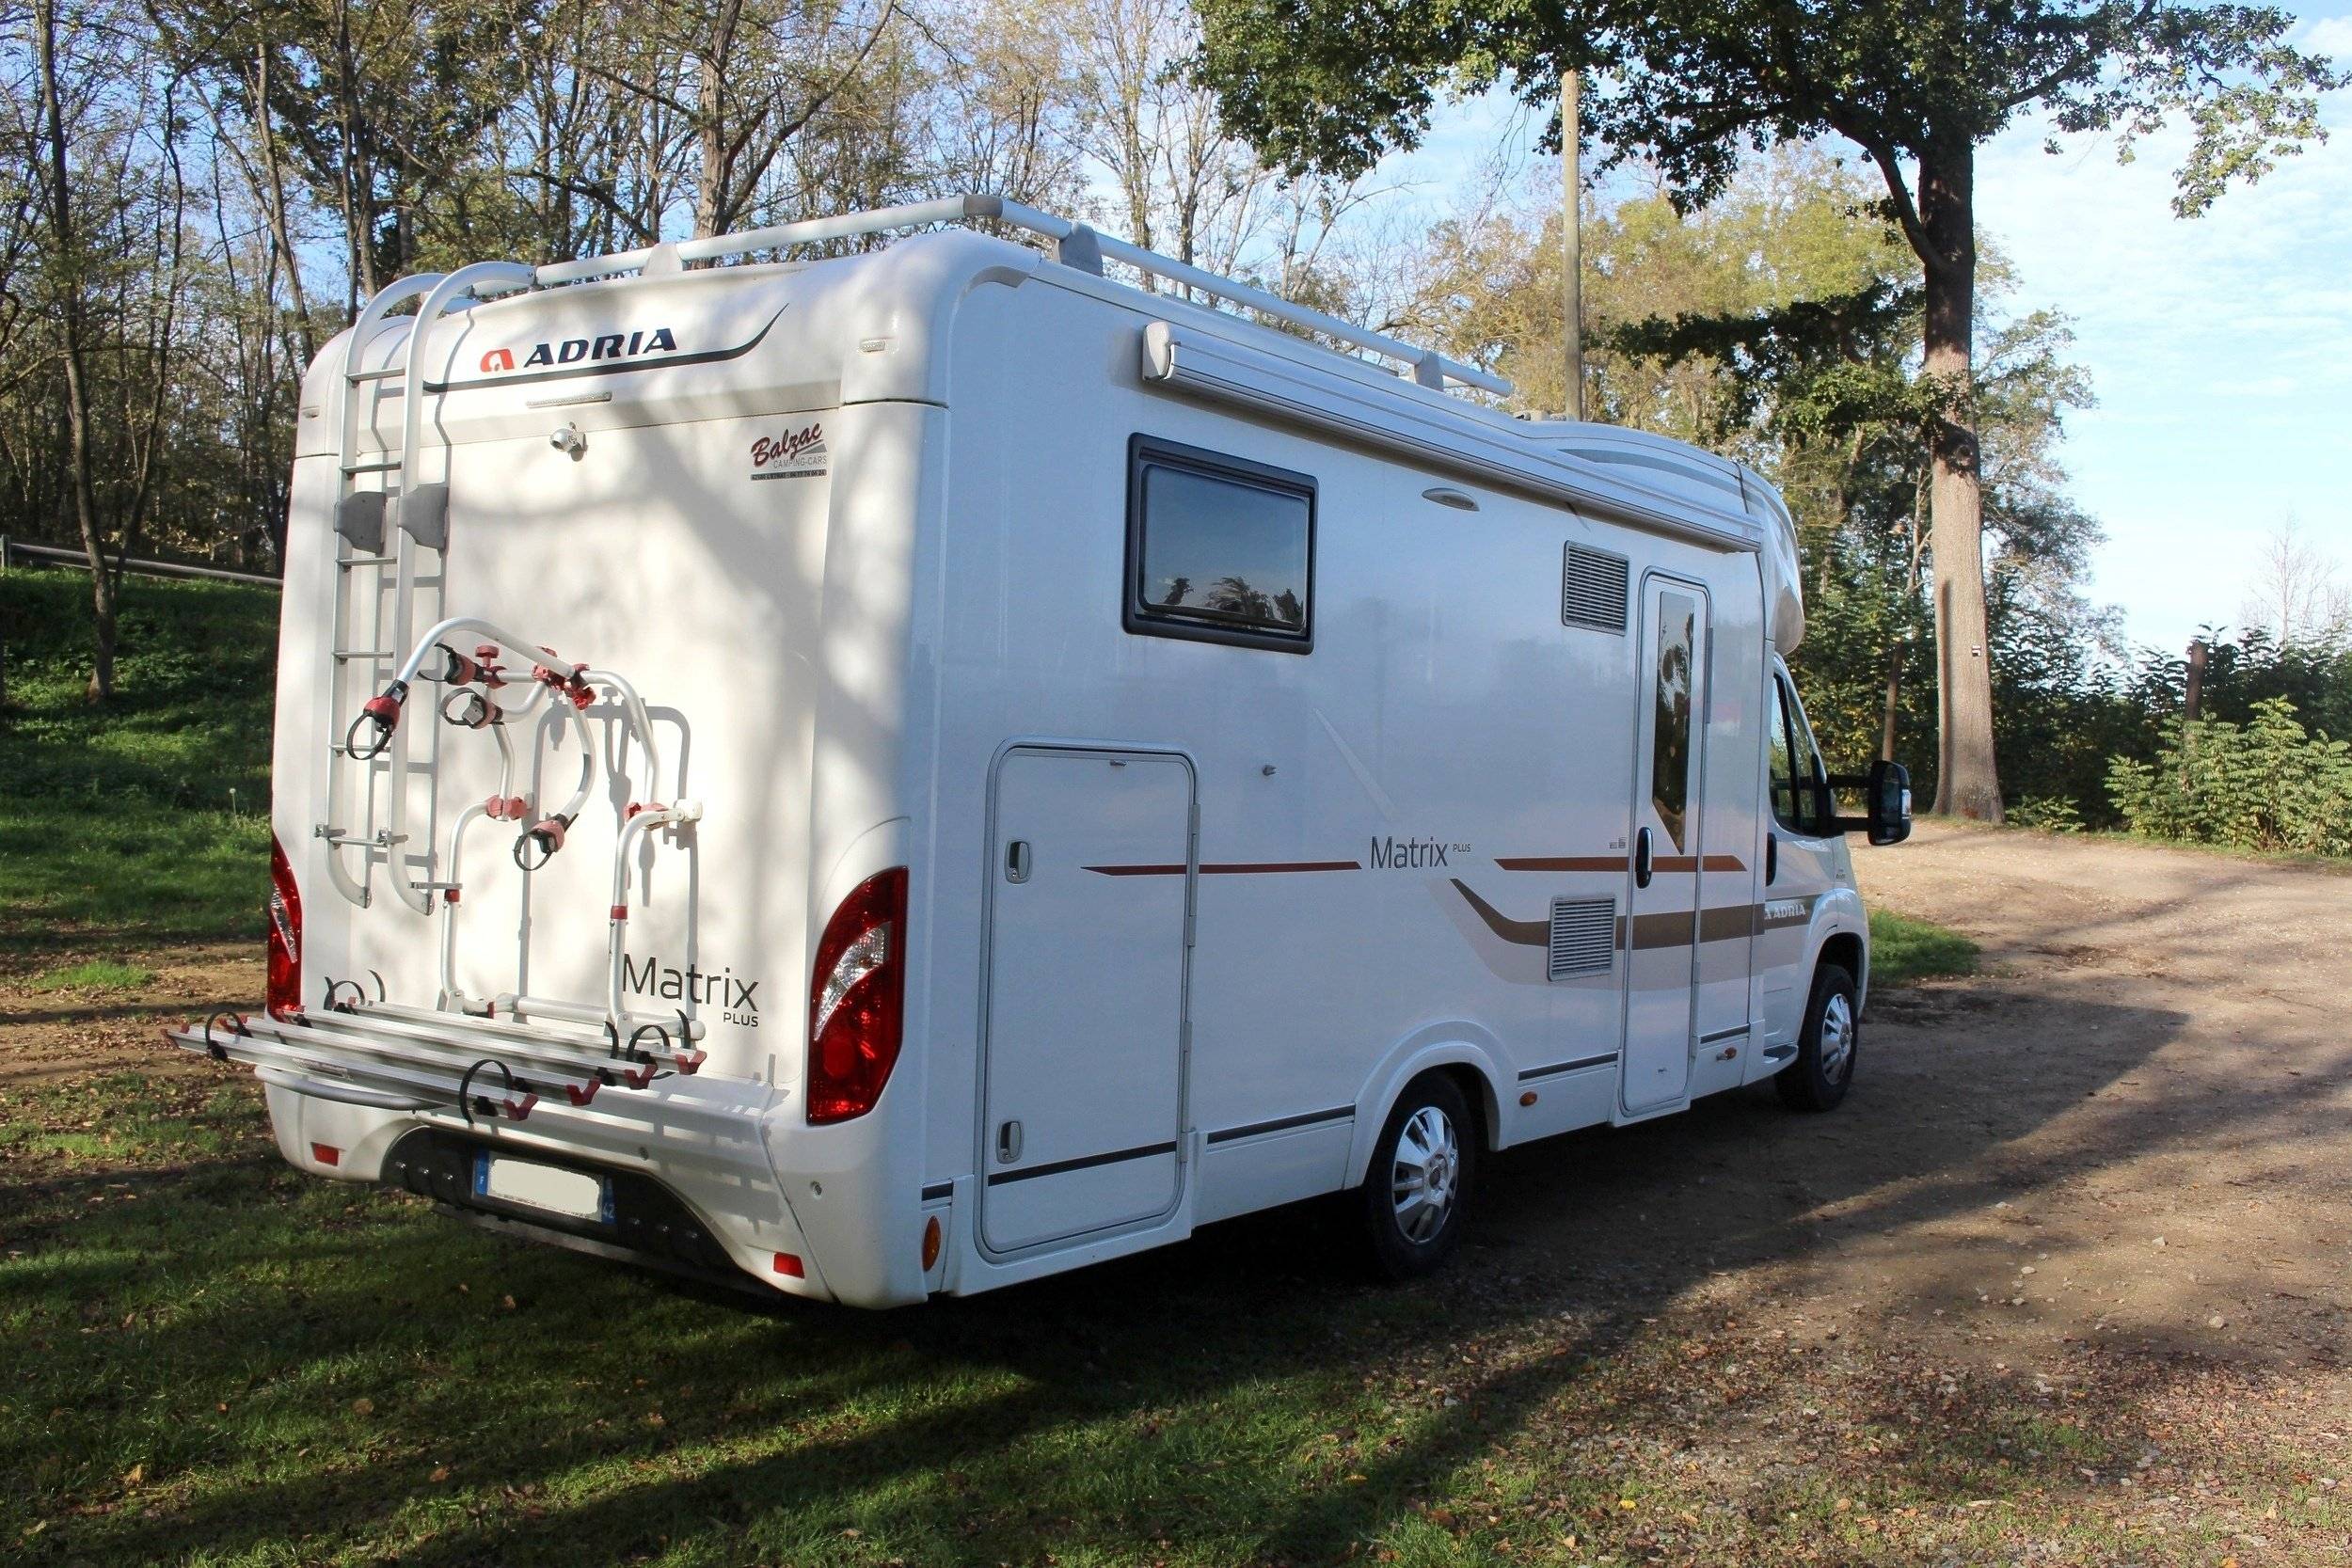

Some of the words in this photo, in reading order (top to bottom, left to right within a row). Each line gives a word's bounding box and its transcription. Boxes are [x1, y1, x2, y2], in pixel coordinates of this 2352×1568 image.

[523, 327, 677, 368] ADRIA
[750, 422, 823, 467] Balzac
[773, 455, 827, 469] CAMPING-CARS
[1370, 835, 1449, 869] Matrix
[1453, 843, 1471, 853] PLUS
[1772, 904, 1806, 919] ADRIA
[622, 953, 759, 1013] Matrix
[723, 1012, 759, 1027] PLUS
